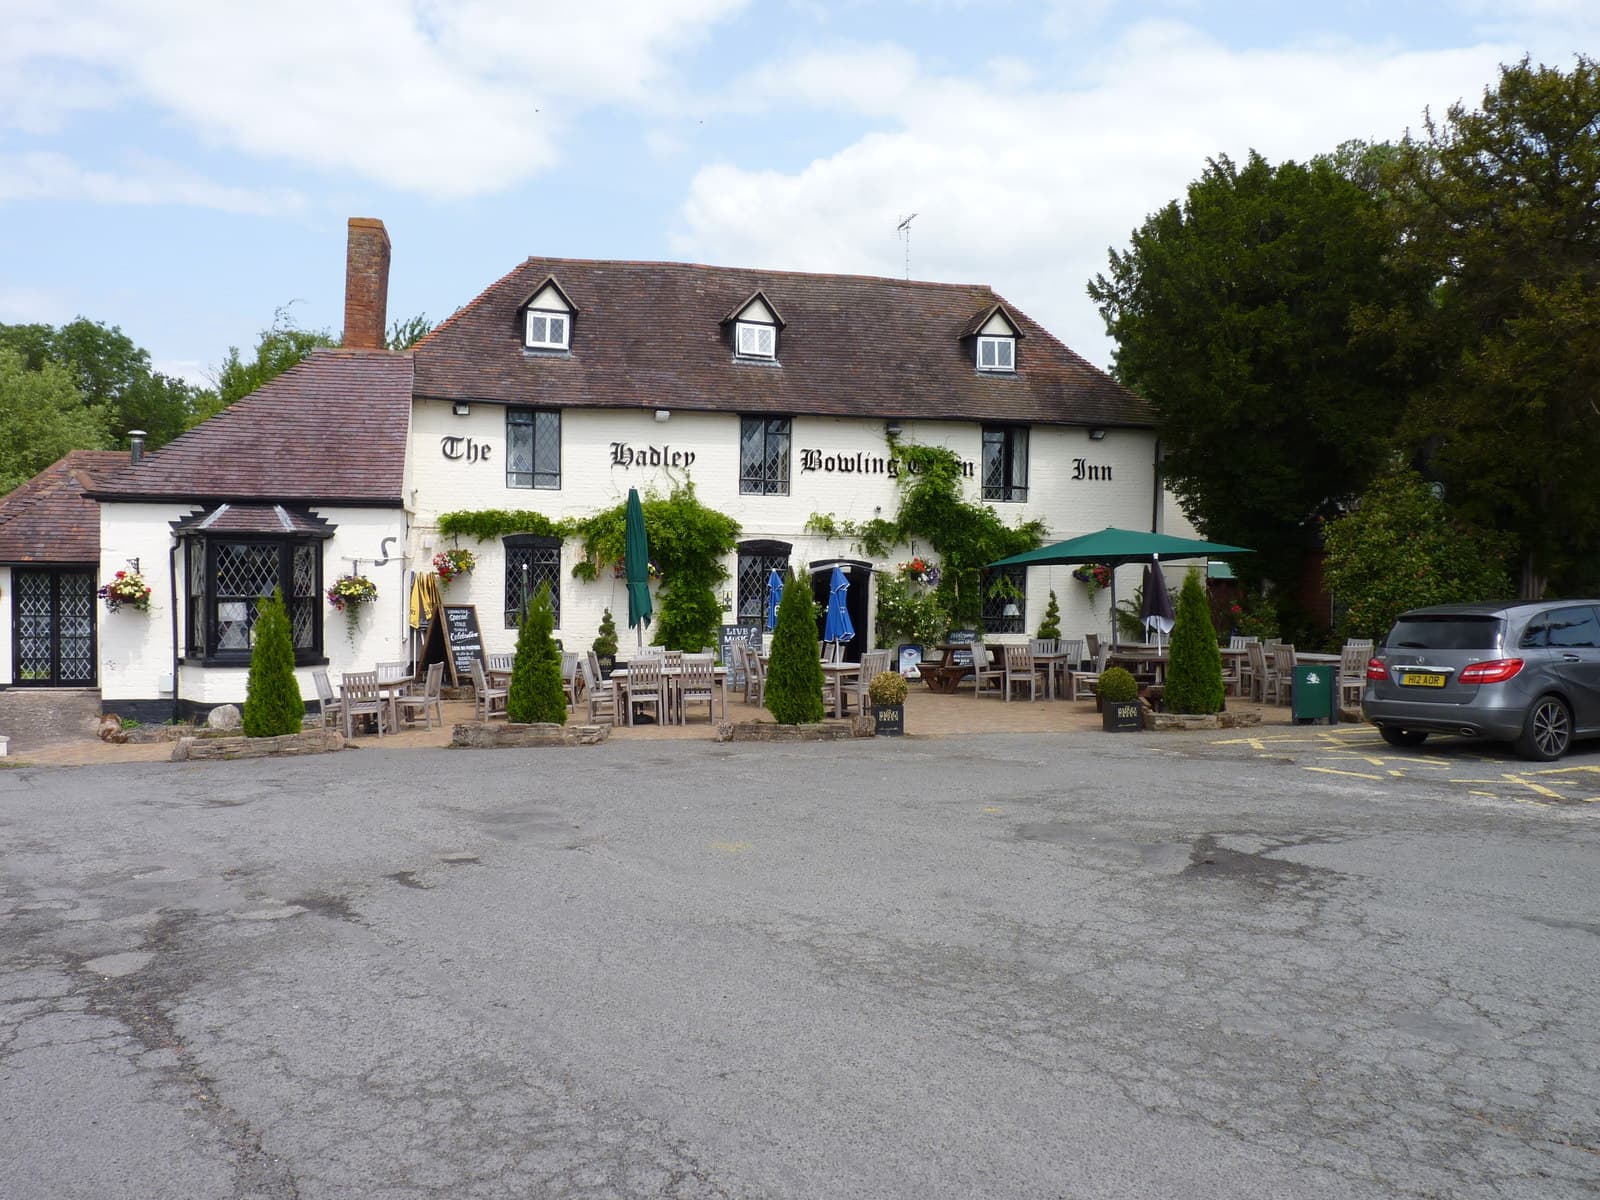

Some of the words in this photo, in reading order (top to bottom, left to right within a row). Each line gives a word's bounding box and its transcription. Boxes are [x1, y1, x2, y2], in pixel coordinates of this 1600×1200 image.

[440, 436, 491, 464] The
[610, 442, 695, 469] Hadley
[800, 449, 900, 478] Bowling
[1071, 458, 1112, 480] Inn
